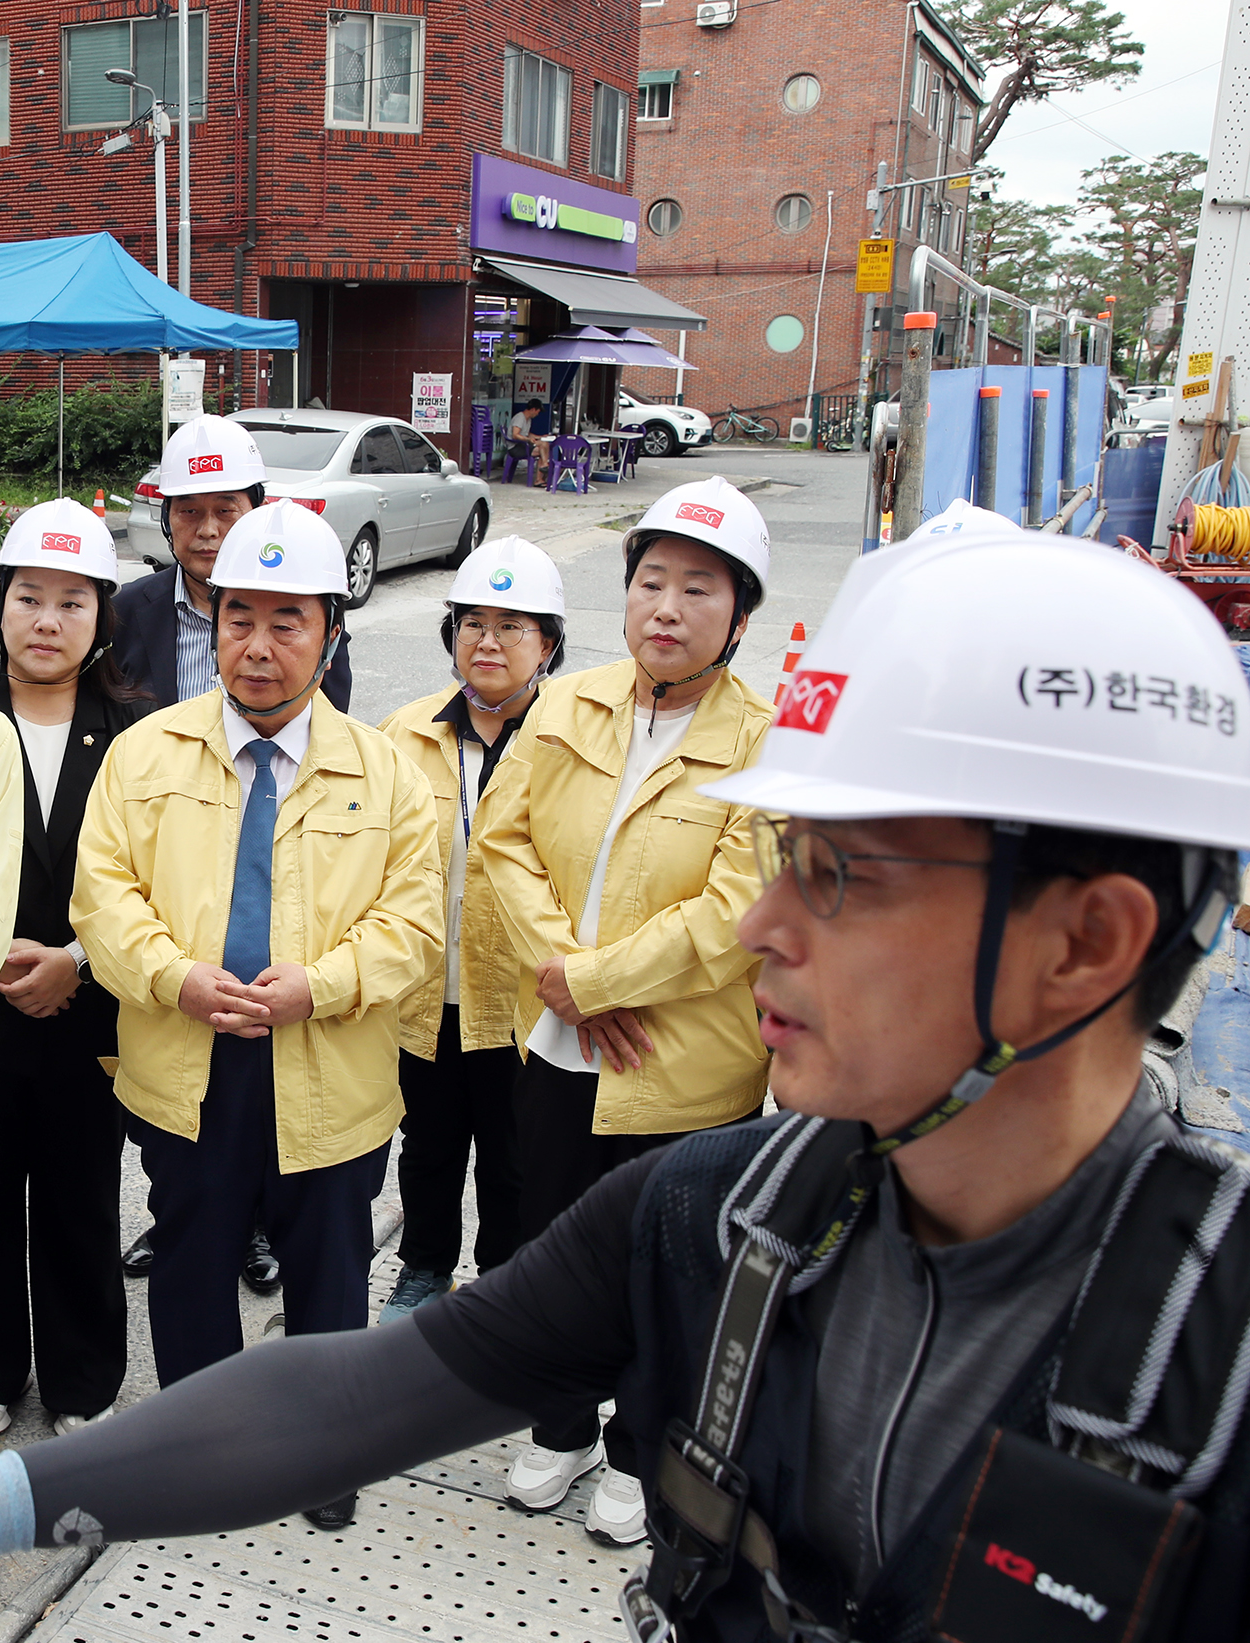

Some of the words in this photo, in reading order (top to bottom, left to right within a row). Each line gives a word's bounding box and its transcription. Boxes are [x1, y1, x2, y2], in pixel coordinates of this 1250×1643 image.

[516, 200, 528, 214] Nice
[528, 205, 535, 216] to
[536, 195, 558, 229] CU
[519, 381, 547, 393] ATM
[705, 1338, 748, 1449] afety
[983, 1541, 1037, 1586] K2
[1034, 1571, 1109, 1623] Safety
